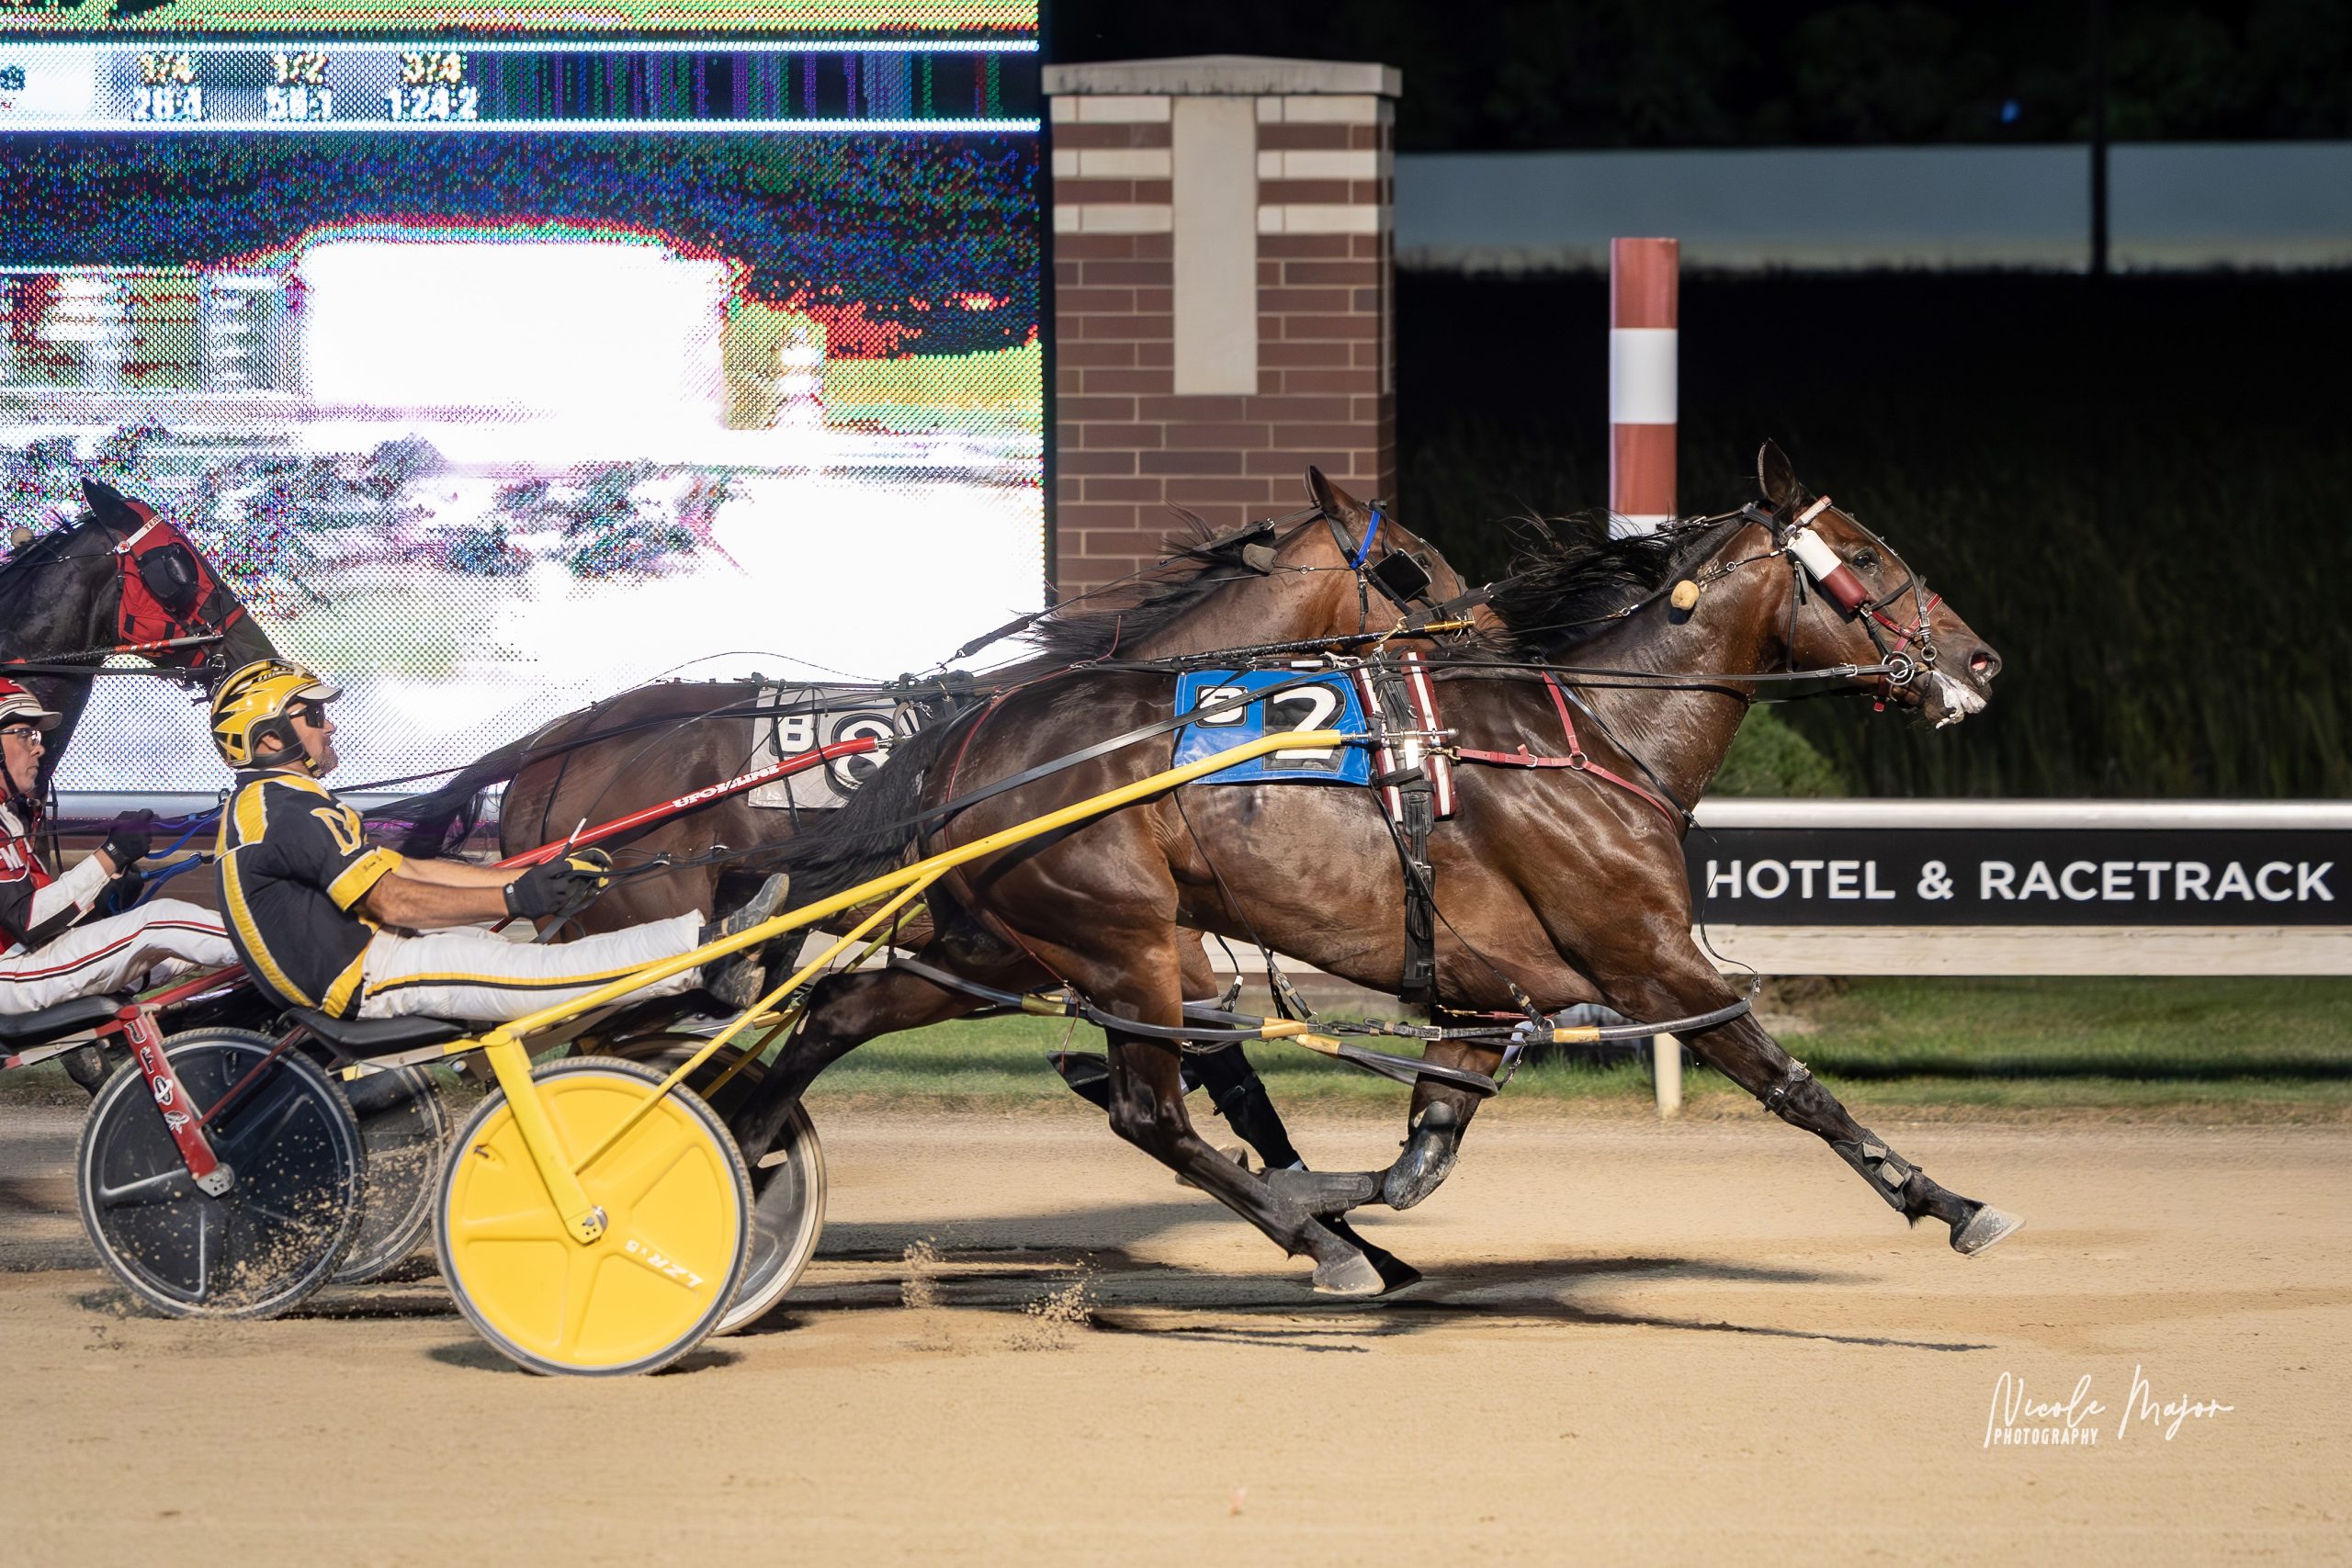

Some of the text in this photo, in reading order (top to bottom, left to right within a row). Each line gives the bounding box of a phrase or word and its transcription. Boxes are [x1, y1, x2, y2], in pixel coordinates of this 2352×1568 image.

[1272, 686, 1336, 759] 2
[1706, 859, 2335, 902] HOTEL & RACETRACK
